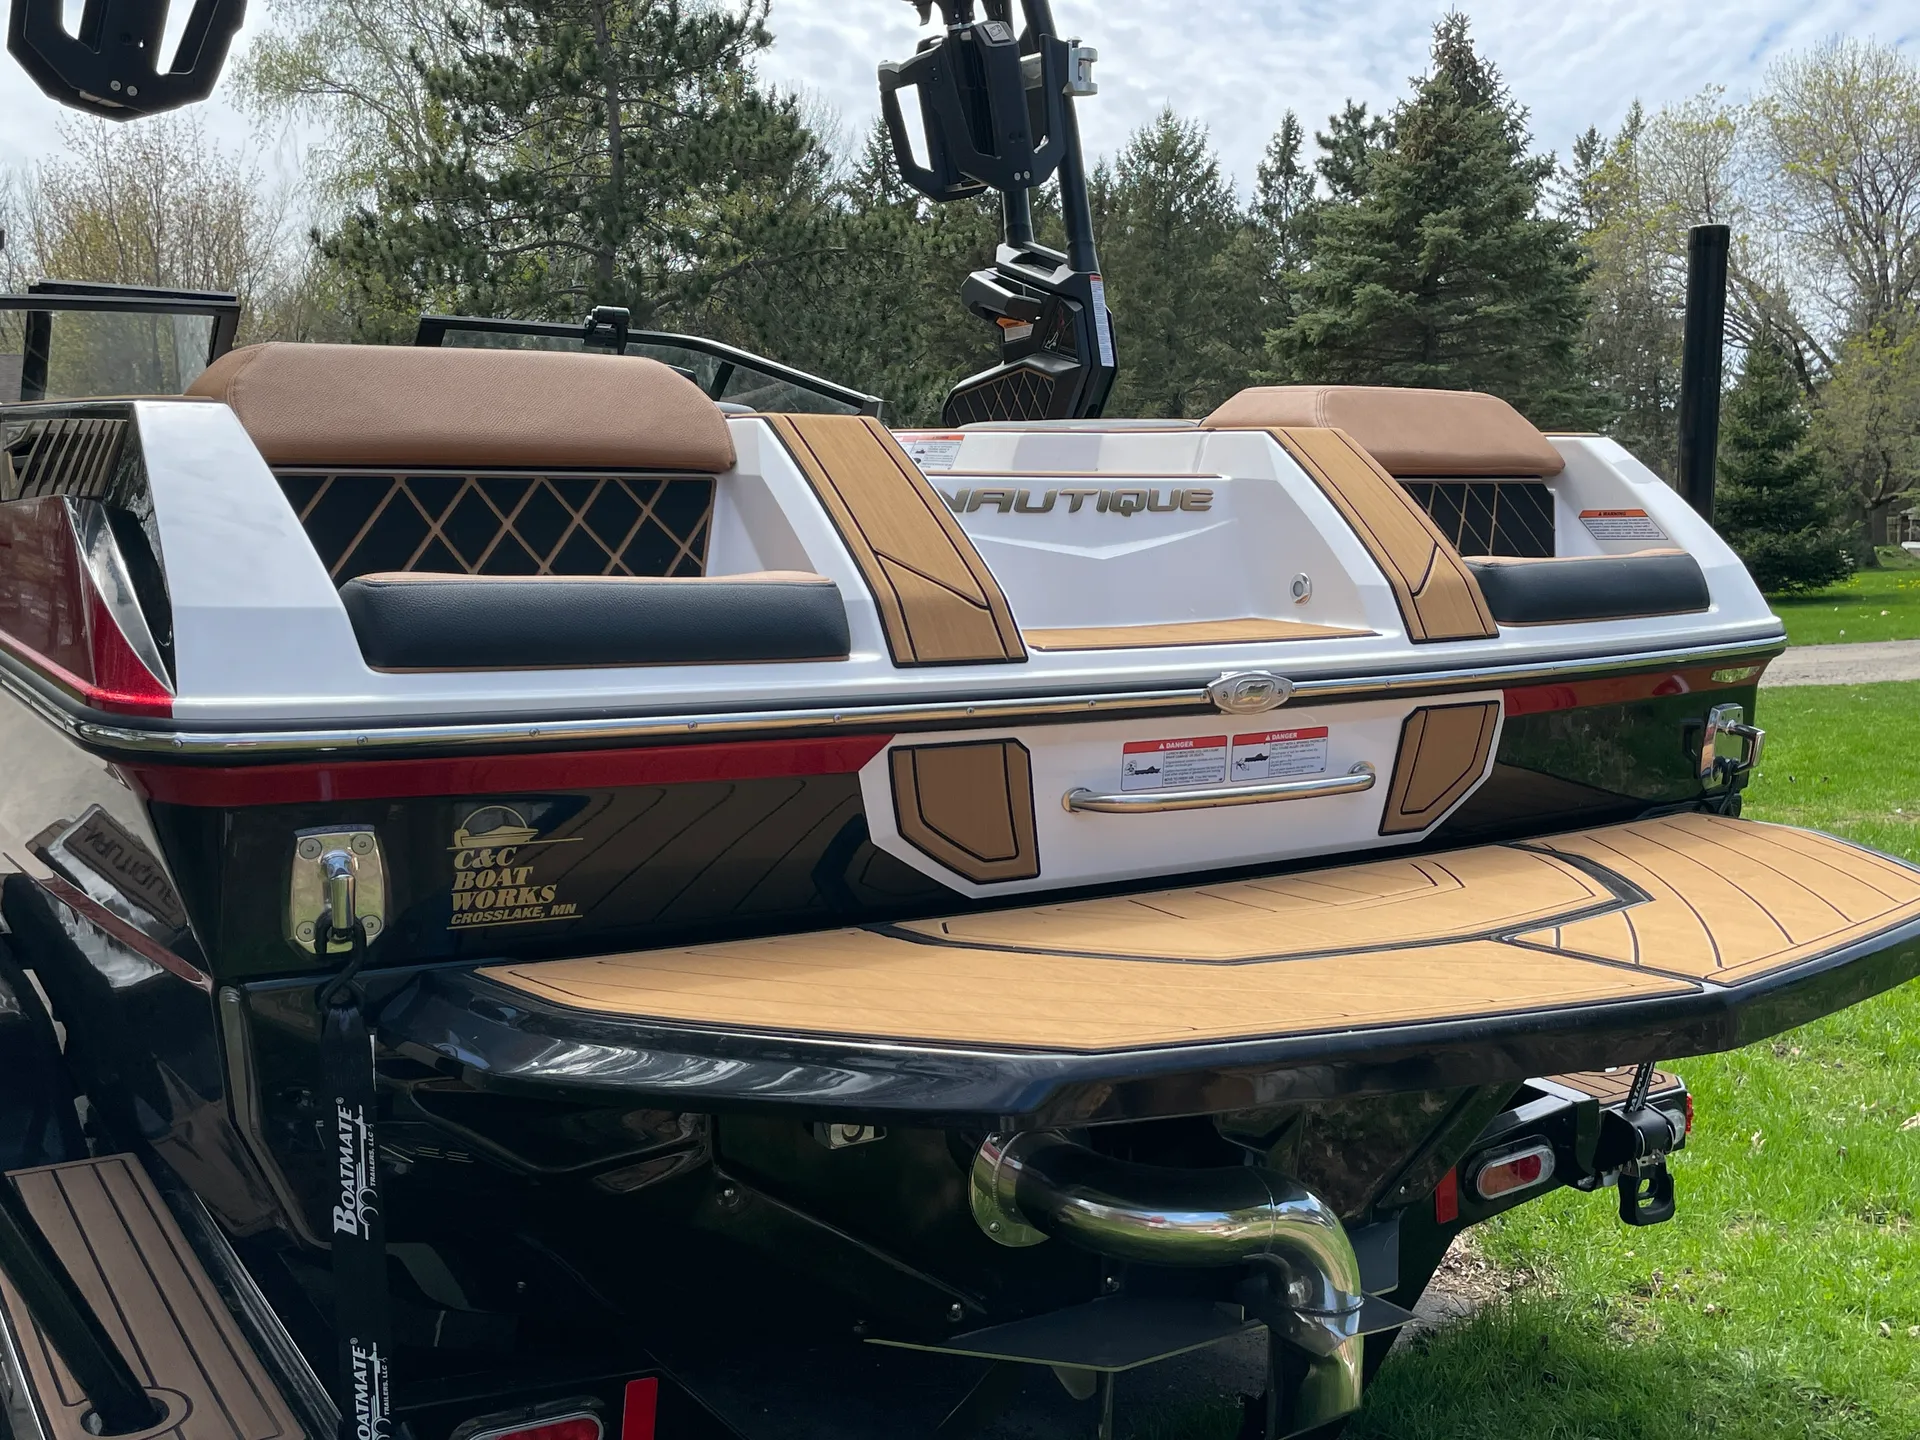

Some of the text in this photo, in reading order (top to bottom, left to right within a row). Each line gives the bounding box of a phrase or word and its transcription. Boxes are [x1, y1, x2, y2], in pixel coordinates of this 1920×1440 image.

[938, 487, 1215, 517] NAUTIQUE
[1166, 740, 1194, 749] DANGER
[1272, 732, 1298, 741] DANGER
[453, 846, 518, 870] C&C
[451, 866, 534, 891] BOAT
[451, 884, 557, 911] WORKS
[451, 903, 577, 925] CROSSLAKE, MN
